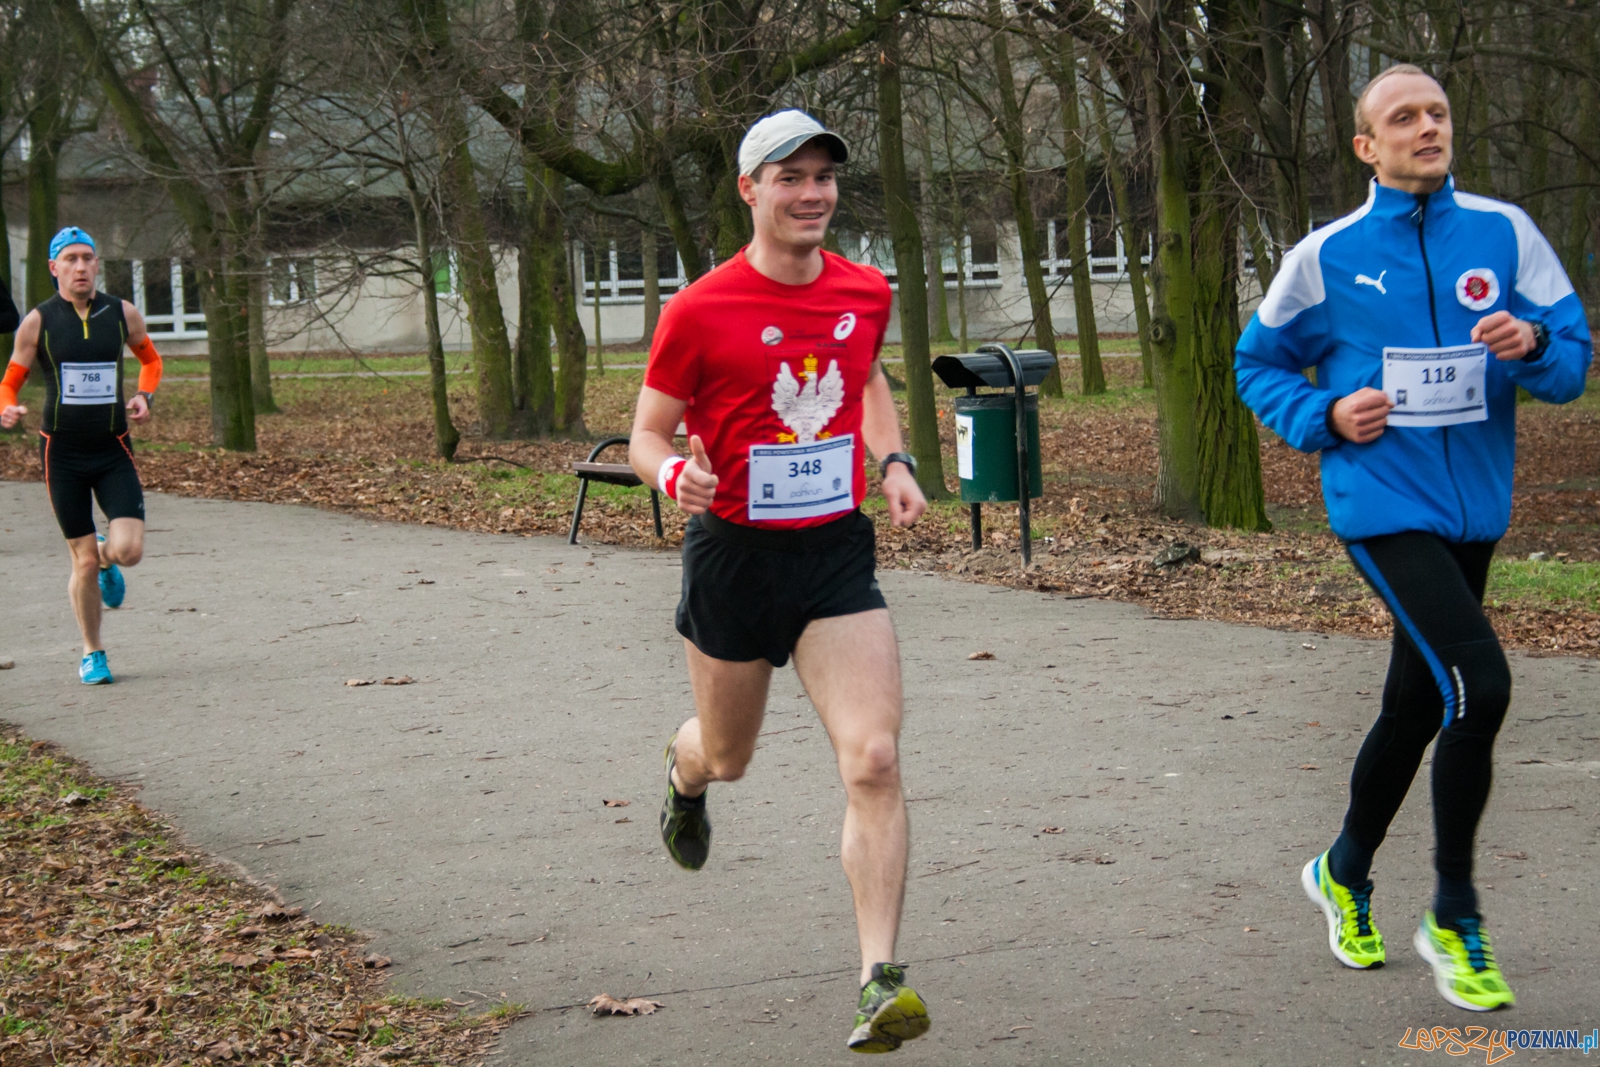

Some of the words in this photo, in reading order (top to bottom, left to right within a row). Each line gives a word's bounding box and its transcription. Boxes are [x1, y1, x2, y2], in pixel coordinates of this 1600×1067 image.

[81, 372, 101, 383] 768
[1421, 365, 1456, 385] 118
[788, 459, 822, 478] 348
